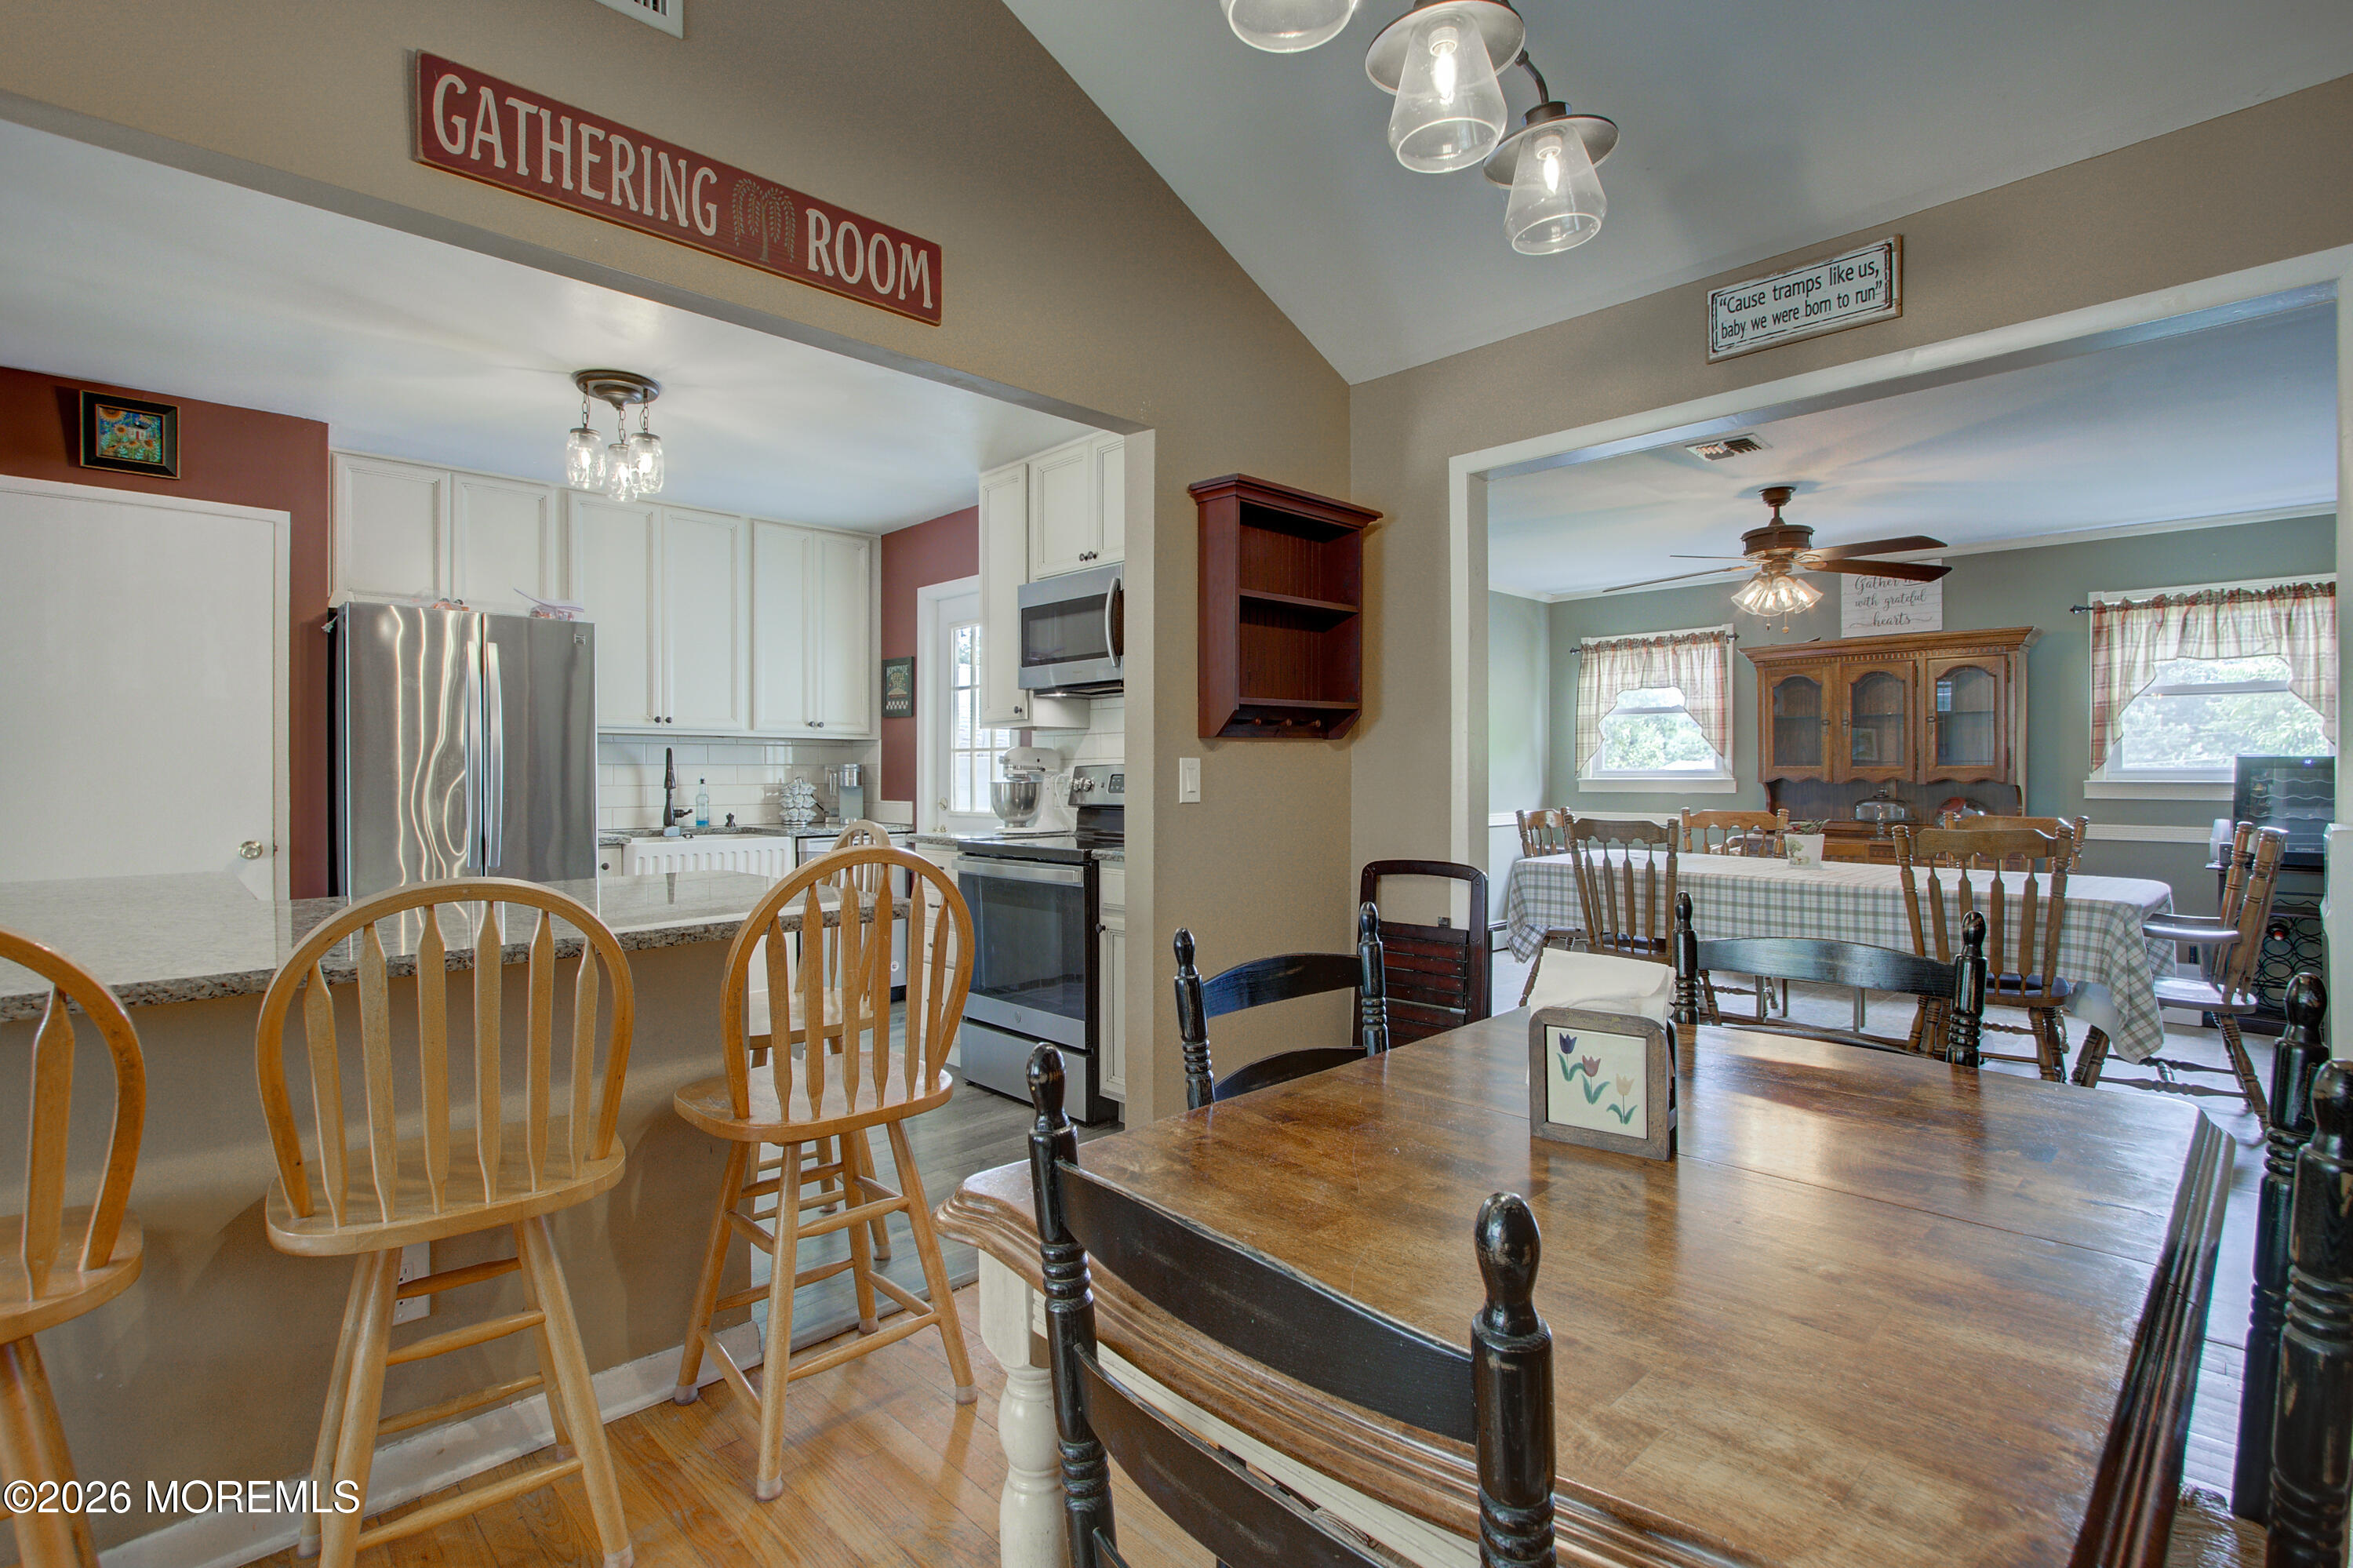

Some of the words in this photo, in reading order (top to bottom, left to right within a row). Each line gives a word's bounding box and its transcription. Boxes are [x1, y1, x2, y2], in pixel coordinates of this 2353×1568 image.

[432, 74, 718, 237] GATHERING
[806, 208, 933, 309] ROOM
[1773, 275, 1821, 301] tramps
[1829, 266, 1854, 286] like
[1859, 260, 1879, 278] us,
[1721, 322, 1747, 339] baby
[1751, 316, 1767, 330] we
[1772, 307, 1799, 326] were
[1805, 300, 1831, 317] born
[1837, 293, 1849, 309] to
[1855, 575, 1899, 595] Gather
[1855, 593, 1878, 608] with
[1883, 588, 1927, 611] grateful
[1873, 611, 1911, 628] hearts
